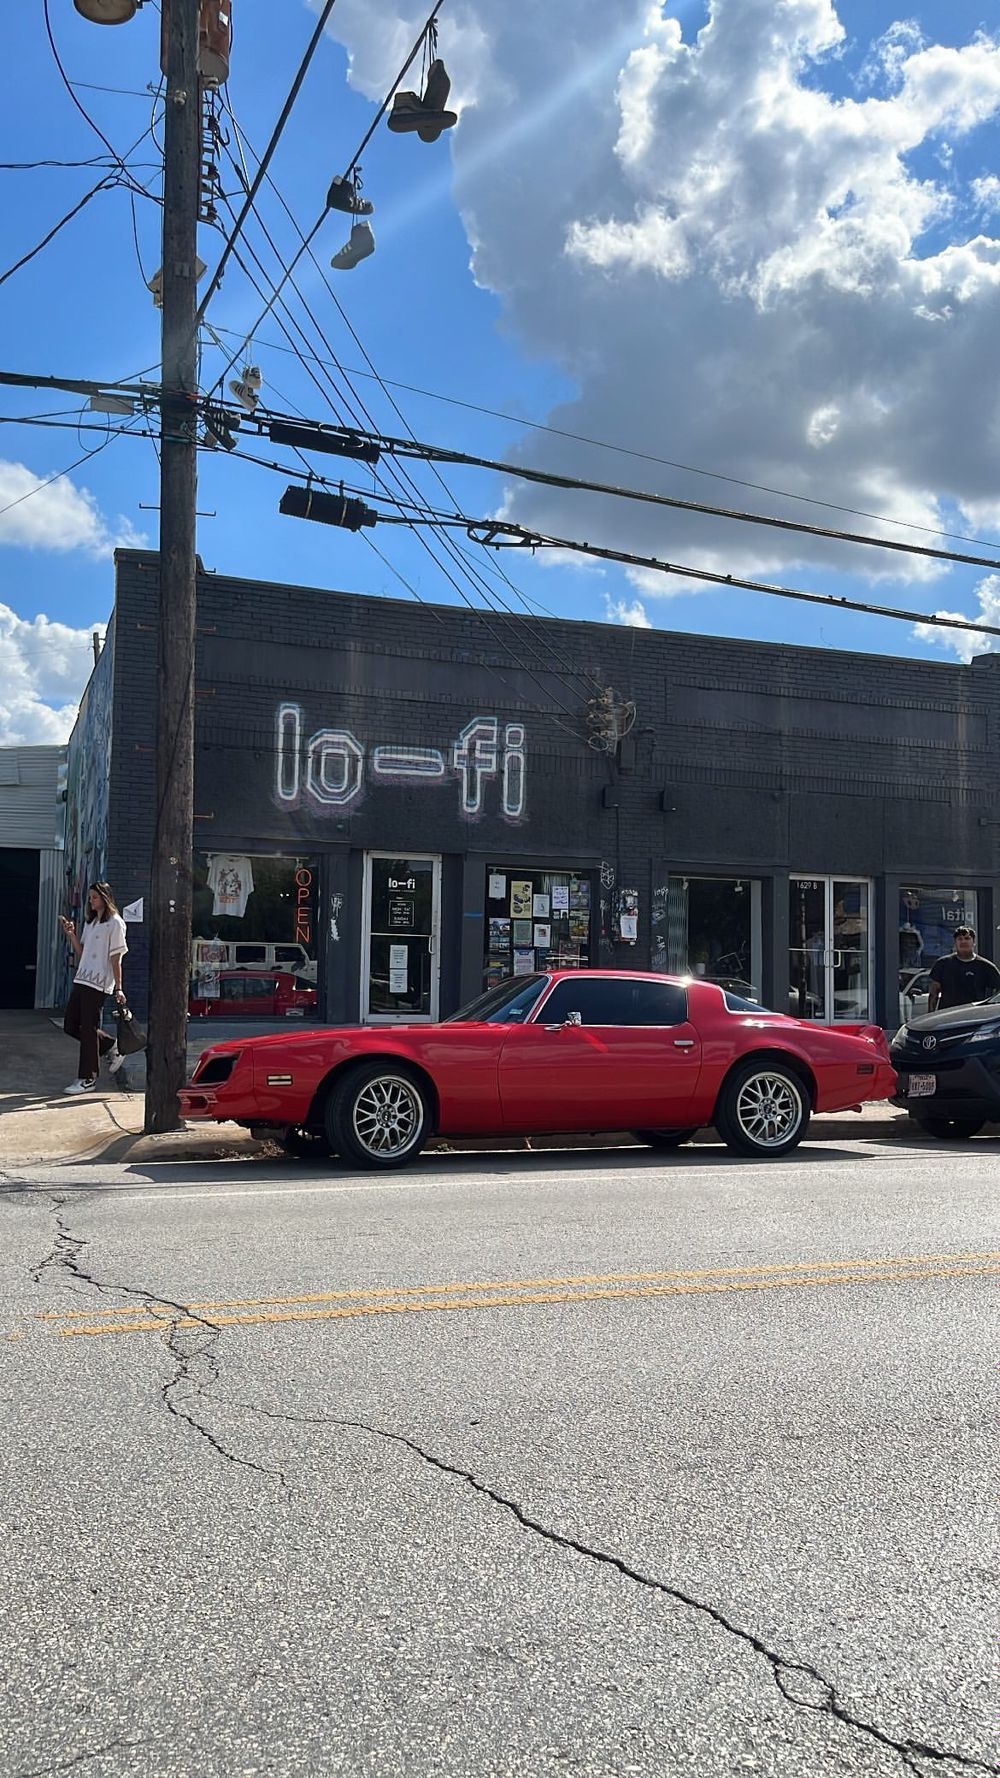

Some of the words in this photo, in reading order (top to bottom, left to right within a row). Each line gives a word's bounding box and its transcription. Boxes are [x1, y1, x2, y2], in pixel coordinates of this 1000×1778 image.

[276, 703, 525, 817] lo-fi
[295, 868, 313, 944] OPEN
[388, 877, 416, 889] lo-fi
